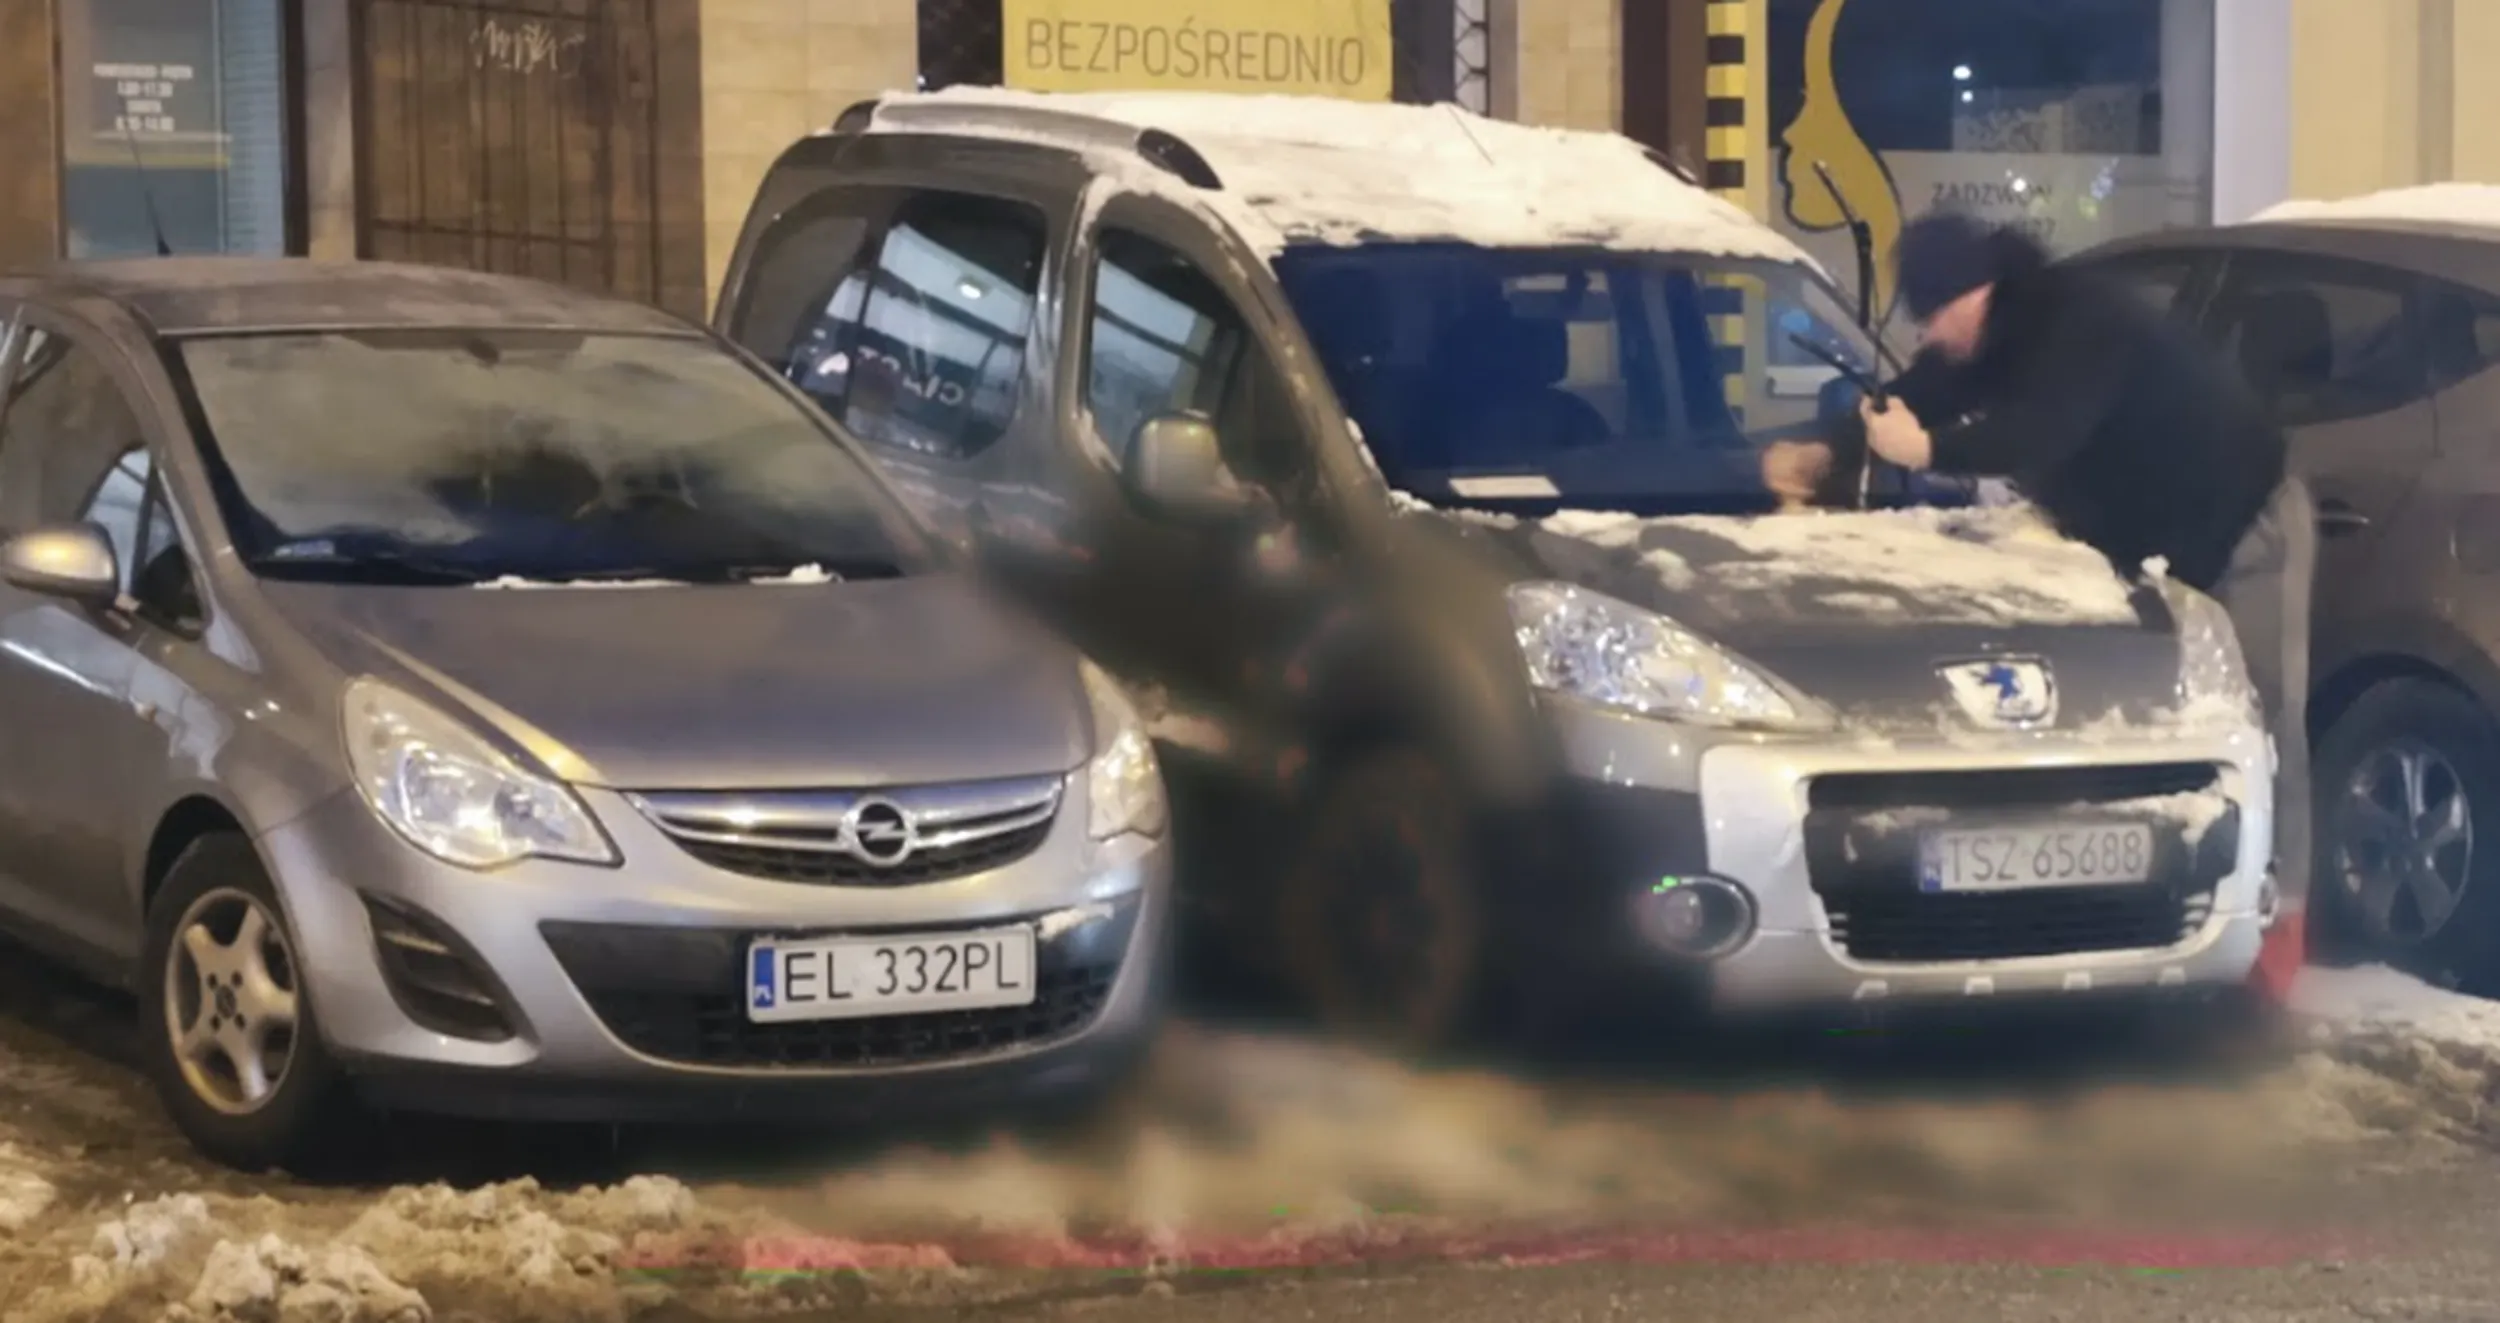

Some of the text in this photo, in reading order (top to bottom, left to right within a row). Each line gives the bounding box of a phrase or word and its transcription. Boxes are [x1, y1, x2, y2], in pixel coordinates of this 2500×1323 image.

[1026, 15, 1366, 87] BEZPOŚREDNIO
[1948, 829, 2143, 882] TSZ 65688
[784, 941, 1020, 1002] EL 332PL
